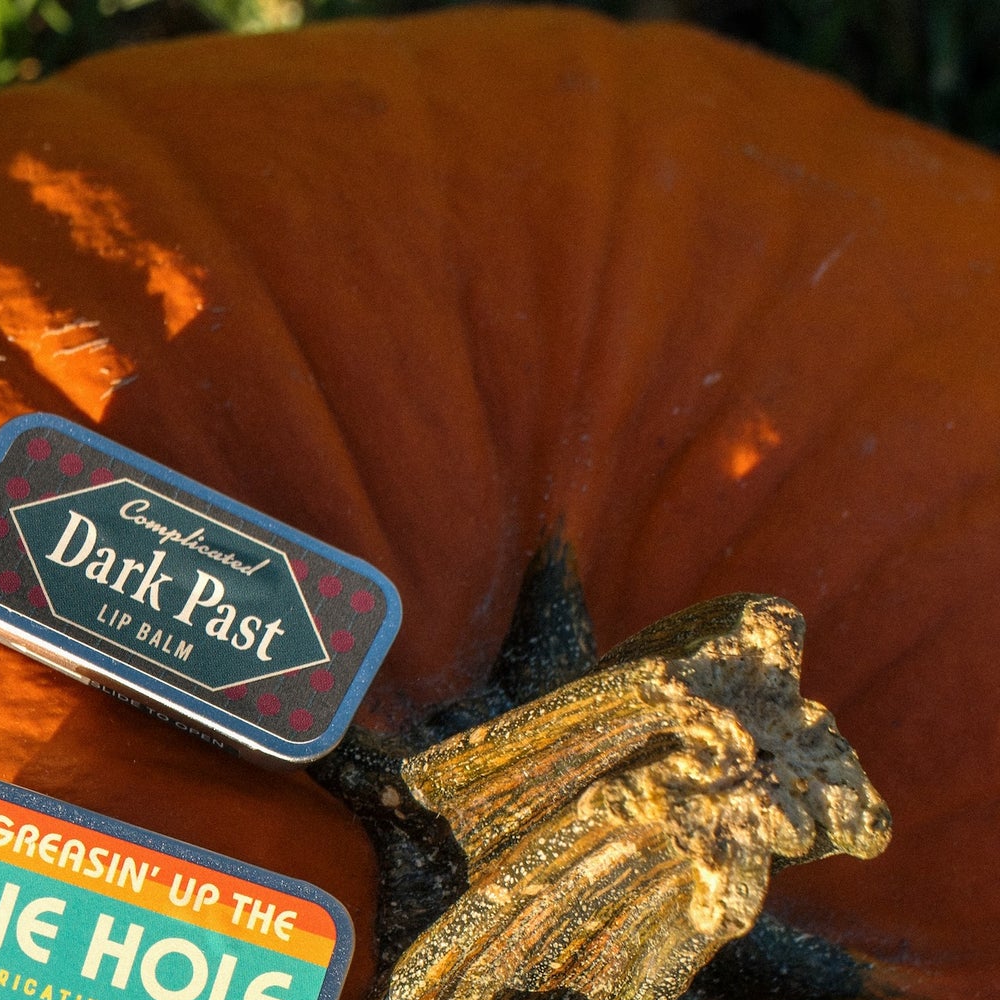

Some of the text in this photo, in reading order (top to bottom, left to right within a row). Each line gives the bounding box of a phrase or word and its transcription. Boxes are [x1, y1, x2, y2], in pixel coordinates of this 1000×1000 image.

[119, 499, 271, 577] Complicated
[45, 510, 286, 662] Dark Past
[96, 603, 194, 662] LIP BALM
[89, 680, 225, 749] SLIDE TO OPEN
[169, 872, 220, 913] UP
[230, 892, 297, 942] THE
